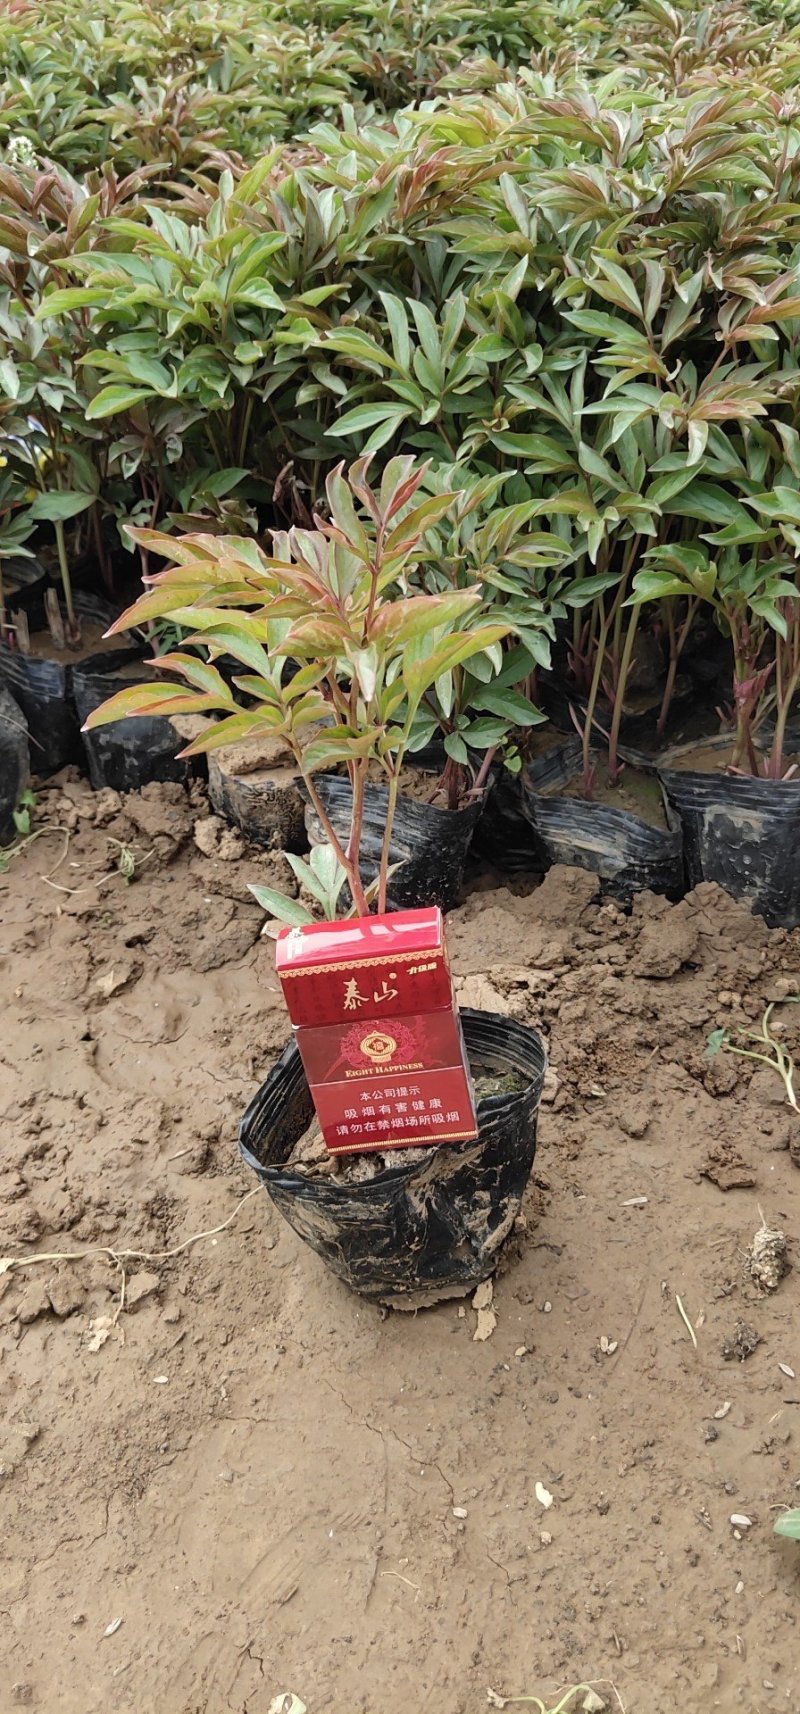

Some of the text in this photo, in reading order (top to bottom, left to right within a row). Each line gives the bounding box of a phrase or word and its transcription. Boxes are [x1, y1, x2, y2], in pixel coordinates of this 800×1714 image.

[343, 977, 399, 1010] 泰山
[345, 1062, 424, 1078] EIGHT HAPPINESS
[360, 1085, 421, 1102] 本公司提示
[344, 1098, 443, 1120] 吸烟有害健康
[336, 1111, 460, 1136] 请勿在禁烟场所吸烟
